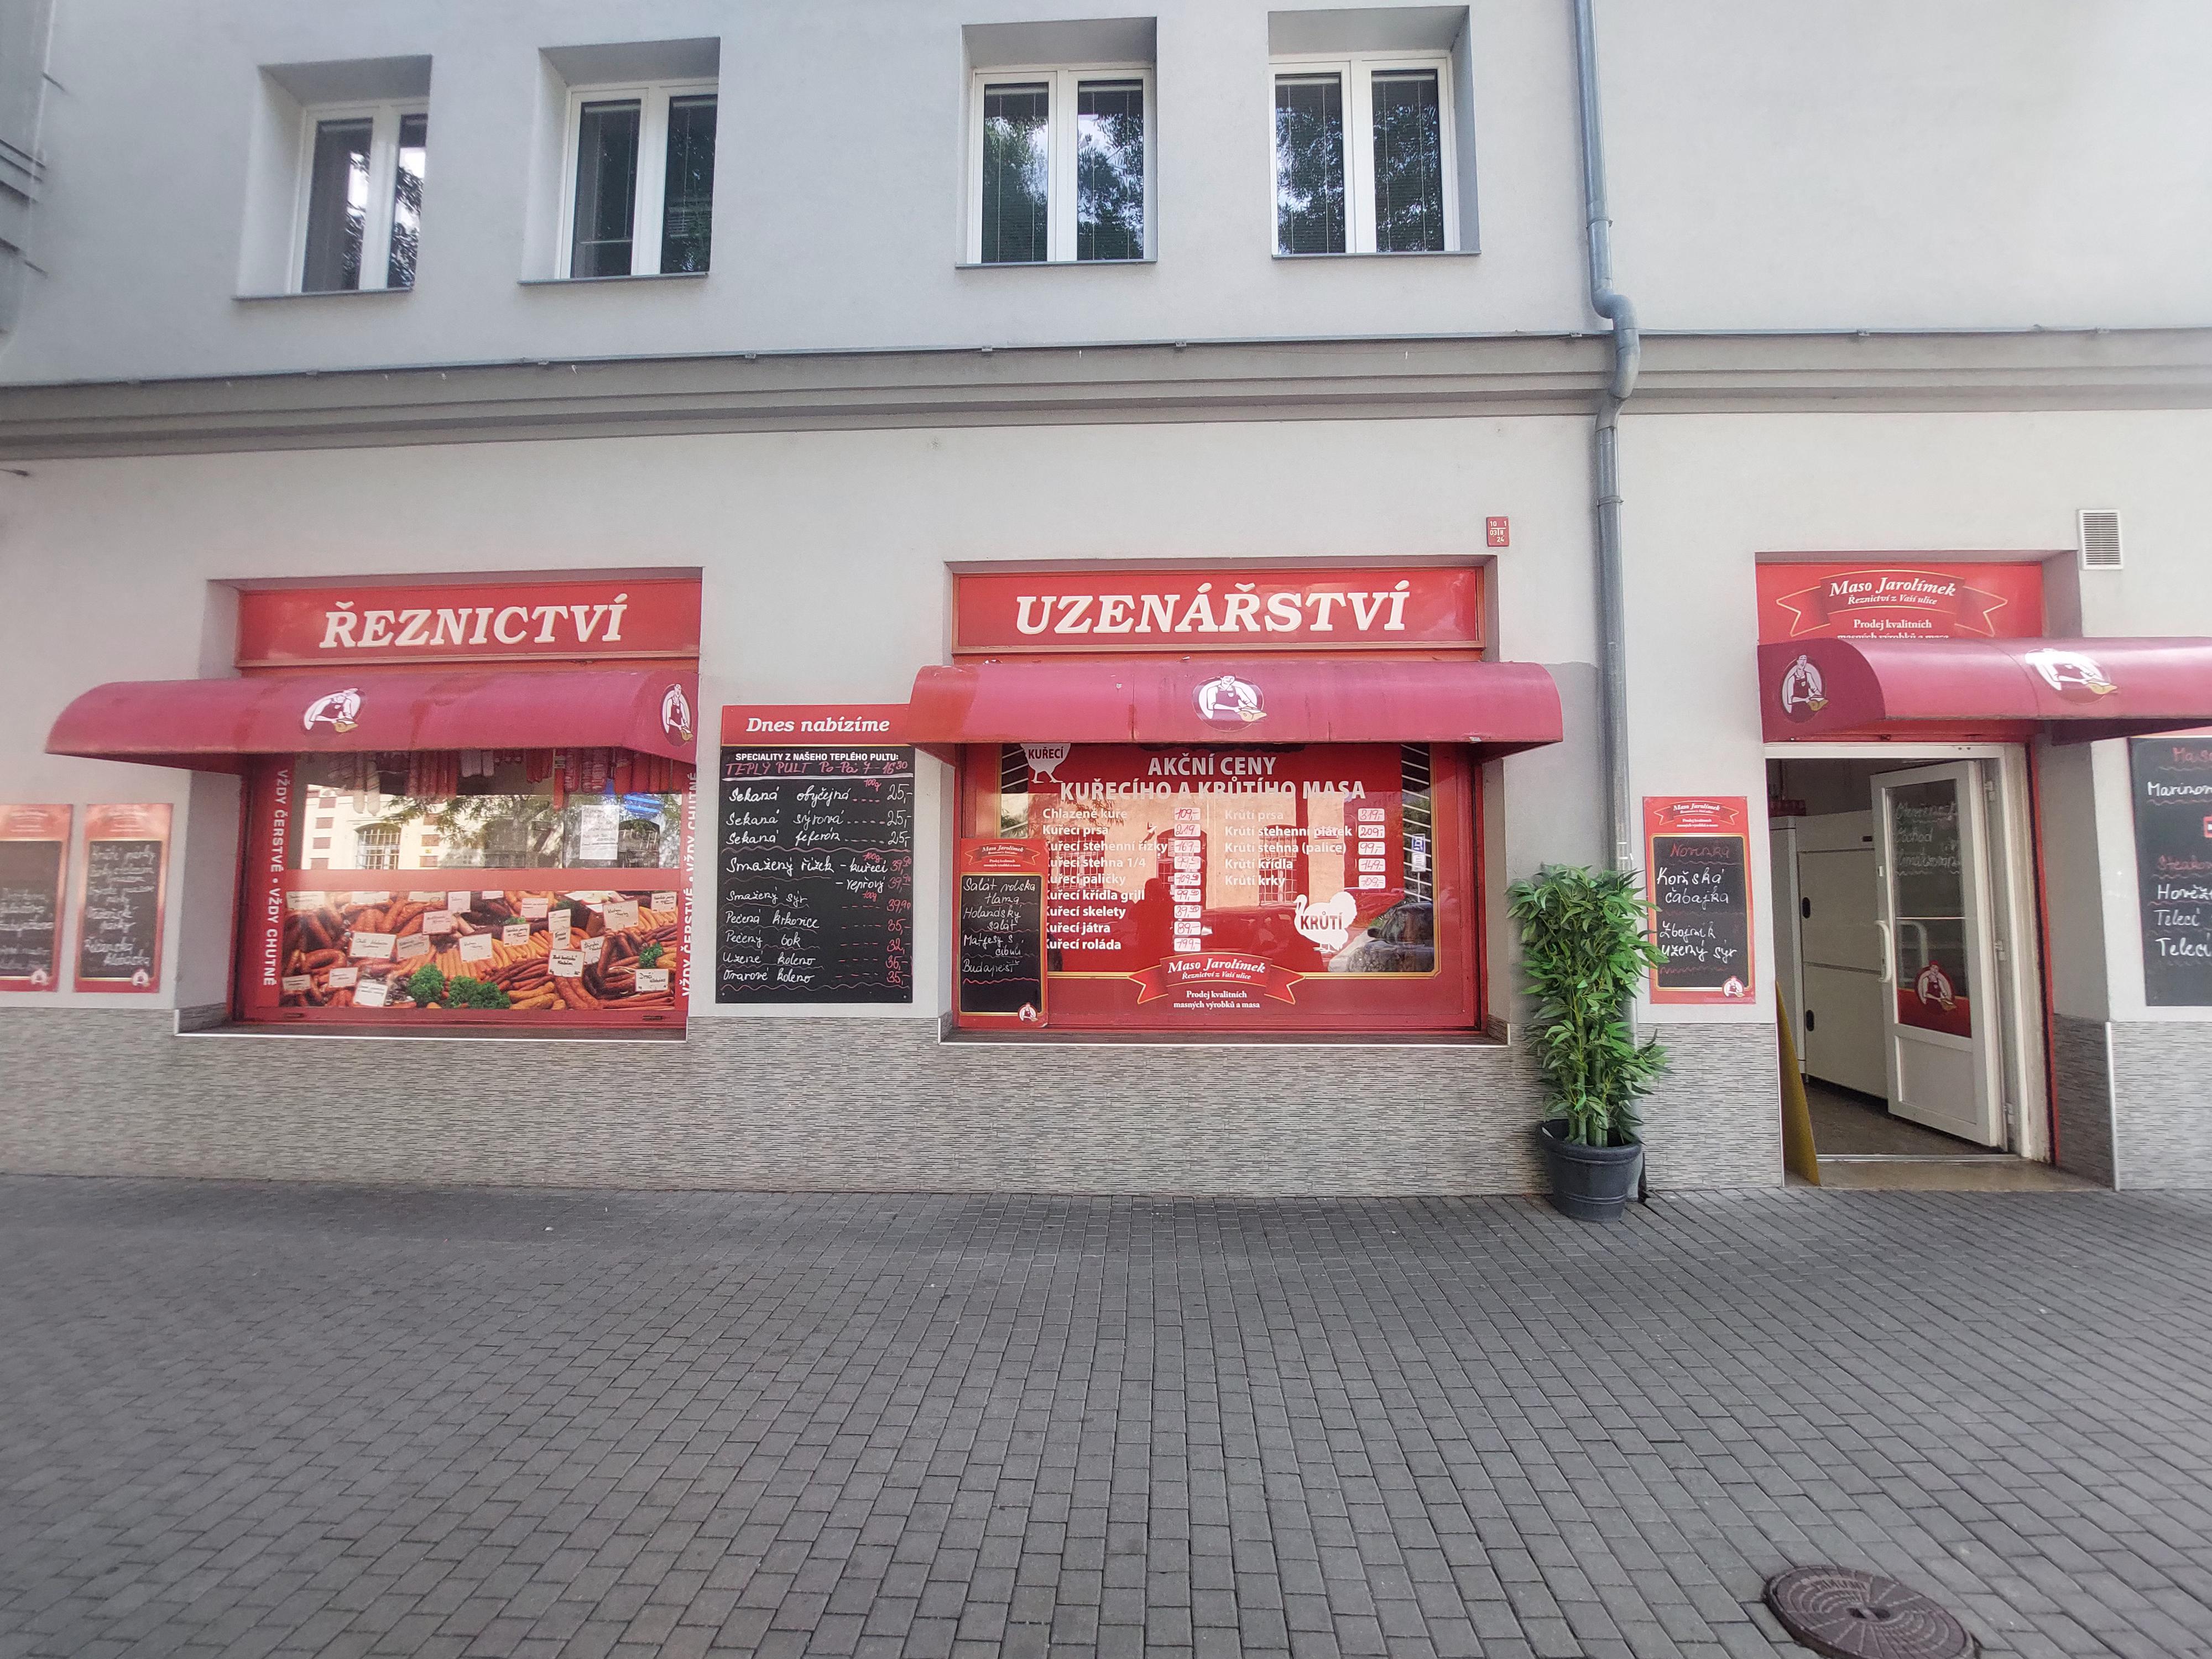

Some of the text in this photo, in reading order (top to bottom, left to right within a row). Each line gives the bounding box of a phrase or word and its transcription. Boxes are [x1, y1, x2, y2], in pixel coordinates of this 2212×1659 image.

[1829, 577, 1956, 597] Maso Jarolímek
[1848, 594, 1890, 604] Řeznictví
[1918, 596, 1938, 605] ulice
[1016, 580, 1410, 635] UZENÁŘSTVÍ
[319, 593, 628, 648] ŘEZNICTVÍ
[1854, 619, 1932, 631] Prodej kvalitních
[746, 717, 890, 732] Dnes nabízíme
[794, 752, 827, 760] NAŠEHO
[830, 752, 868, 760] TEPLÉHO
[1027, 747, 1064, 759] KUŘECÍ
[725, 761, 770, 776] TEPLÝ
[775, 762, 812, 774] PULT
[1147, 753, 1276, 775] AKČNÍ CENY
[1061, 776, 1366, 801] KUŘECÍHO A KRŮTÍHO MASA
[728, 786, 780, 802] Sekaná
[796, 785, 851, 807] obyčejná
[726, 809, 780, 826] Sekaná
[1042, 808, 1128, 819] Chlazené kuře
[1225, 809, 1284, 822] Krůtí prsa
[726, 830, 779, 844] Sekaná
[1042, 825, 1109, 837] Kuřecí prsa
[1225, 826, 1352, 838] Krůtí stehenní plátek
[1083, 841, 1135, 851] stehenní
[1139, 841, 1168, 853] řízky
[1225, 842, 1346, 854] Krůtí stehna (palice)
[726, 857, 793, 876] Smažený
[801, 856, 834, 873] řízek
[1083, 857, 1123, 868] stehna
[1127, 858, 1146, 868] 1/4
[1225, 858, 1293, 869] Krůtí křídla
[263, 769, 291, 986] VŽDY ČERSTVÉ VŽDY CHUTNÉ
[1082, 874, 1126, 886] paličky
[1225, 875, 1285, 888] Krůtí krky
[963, 878, 997, 891] Salát
[726, 886, 779, 904] Smažený
[786, 890, 807, 907] sýr
[1083, 889, 1118, 900] křídla
[1120, 890, 1145, 902] grill
[1665, 885, 1729, 910] čabajka
[725, 908, 761, 924] Pečená
[963, 904, 1022, 924] Holandský
[1082, 906, 1126, 919] skelety
[2153, 907, 2200, 926] Telecí
[987, 920, 1017, 931] salát
[1300, 911, 1342, 930] KRŮTÍ
[1082, 922, 1110, 935] játra
[725, 930, 763, 948] Pečený
[781, 933, 801, 947] bok
[1008, 935, 1013, 943] s
[1082, 938, 1121, 950] roláda
[1713, 940, 1738, 963] sýr
[777, 952, 816, 966] koleno
[1167, 958, 1266, 973] Maso Jarolímek
[776, 968, 815, 983] koleno
[1182, 971, 1214, 979] Řeznictví
[1186, 990, 1209, 1000] Prodej
[1173, 1001, 1204, 1010] masných
[1206, 1001, 1235, 1010] výrobků
